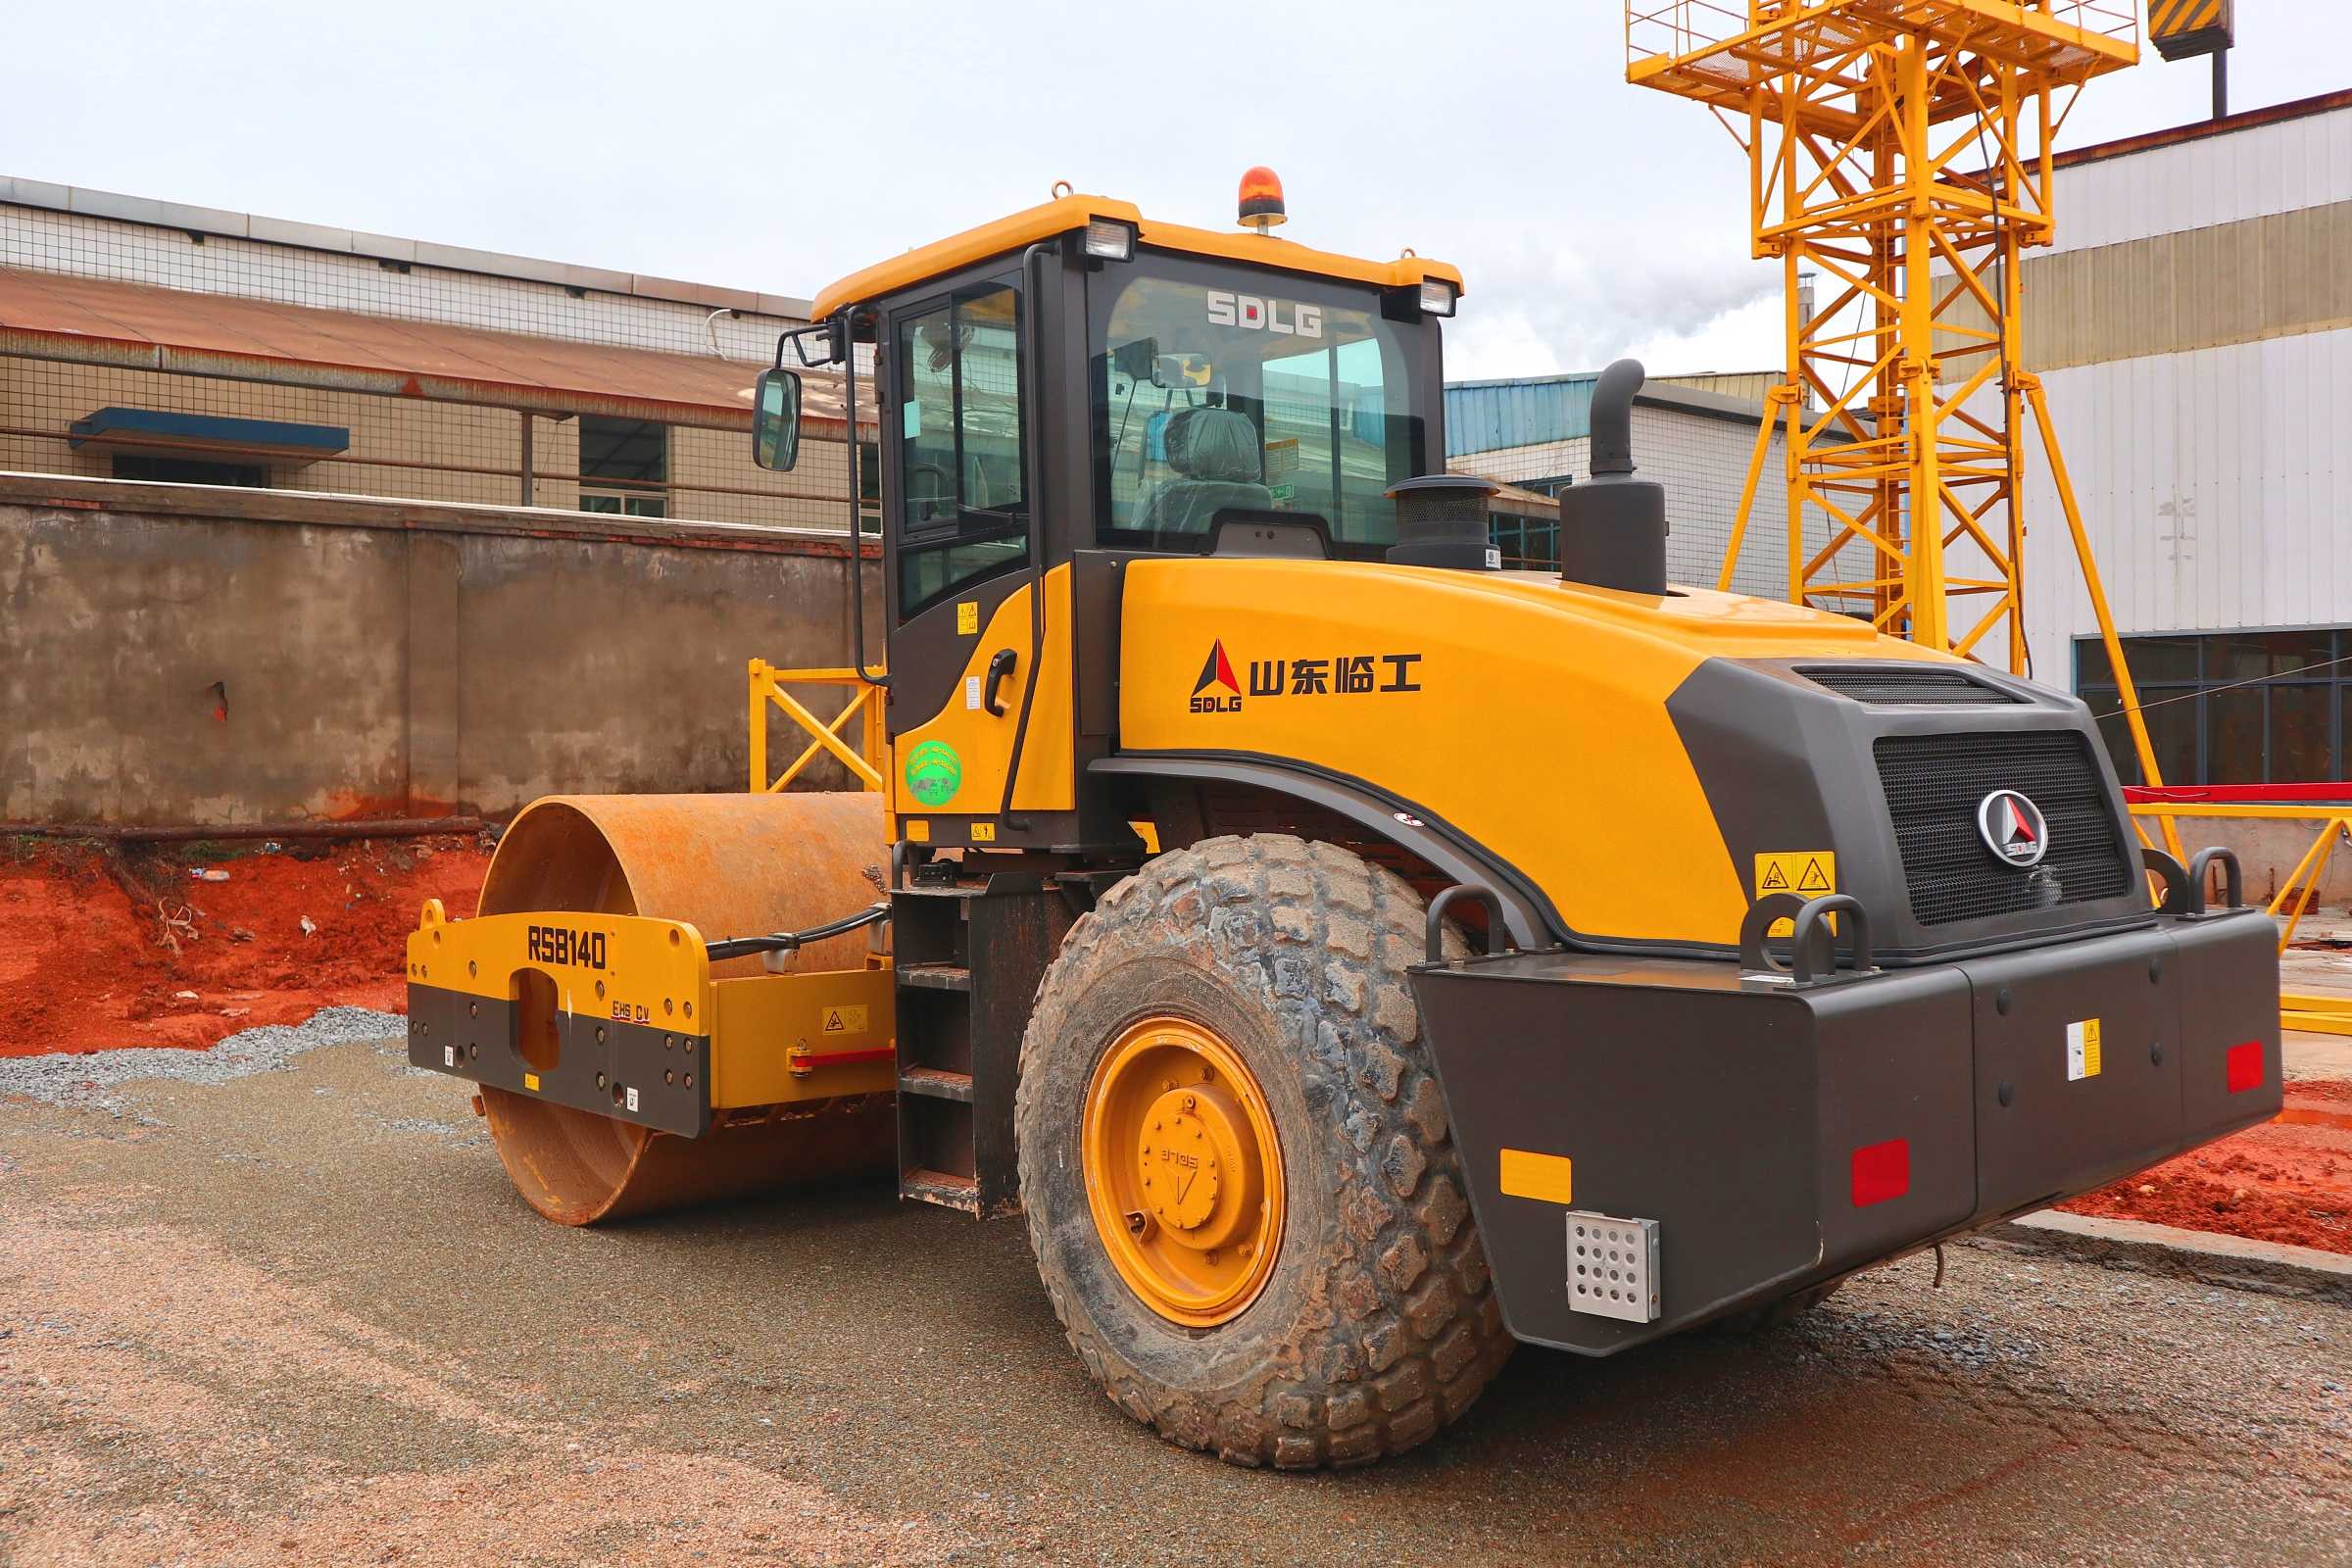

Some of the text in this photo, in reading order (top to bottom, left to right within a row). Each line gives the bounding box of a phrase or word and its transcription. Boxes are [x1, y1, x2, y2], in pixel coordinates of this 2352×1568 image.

[1207, 290, 1322, 338] SDLG
[1250, 654, 1421, 697] 山东临工
[1190, 696, 1242, 713] SDLG
